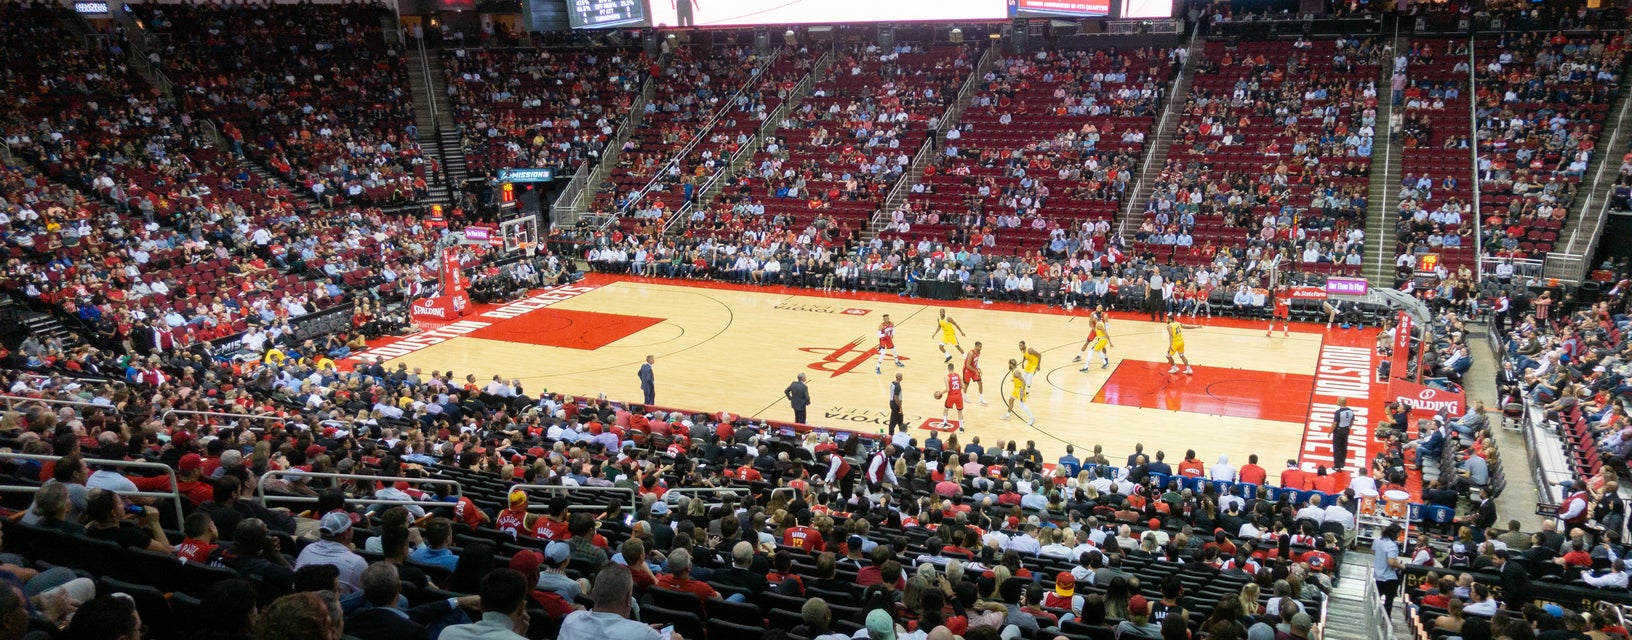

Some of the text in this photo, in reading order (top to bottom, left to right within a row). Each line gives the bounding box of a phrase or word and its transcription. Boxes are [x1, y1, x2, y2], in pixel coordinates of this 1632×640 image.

[413, 305, 444, 317] SPALDING
[350, 286, 595, 361] HOUSTON ROCKETS
[1400, 315, 1409, 348] NBA TV
[1301, 345, 1370, 479] HOUSTON ROCKETS
[499, 515, 521, 527] HARDEN
[537, 527, 555, 539] HARDEN
[792, 538, 804, 547] 13
[181, 543, 199, 557] PAUL
